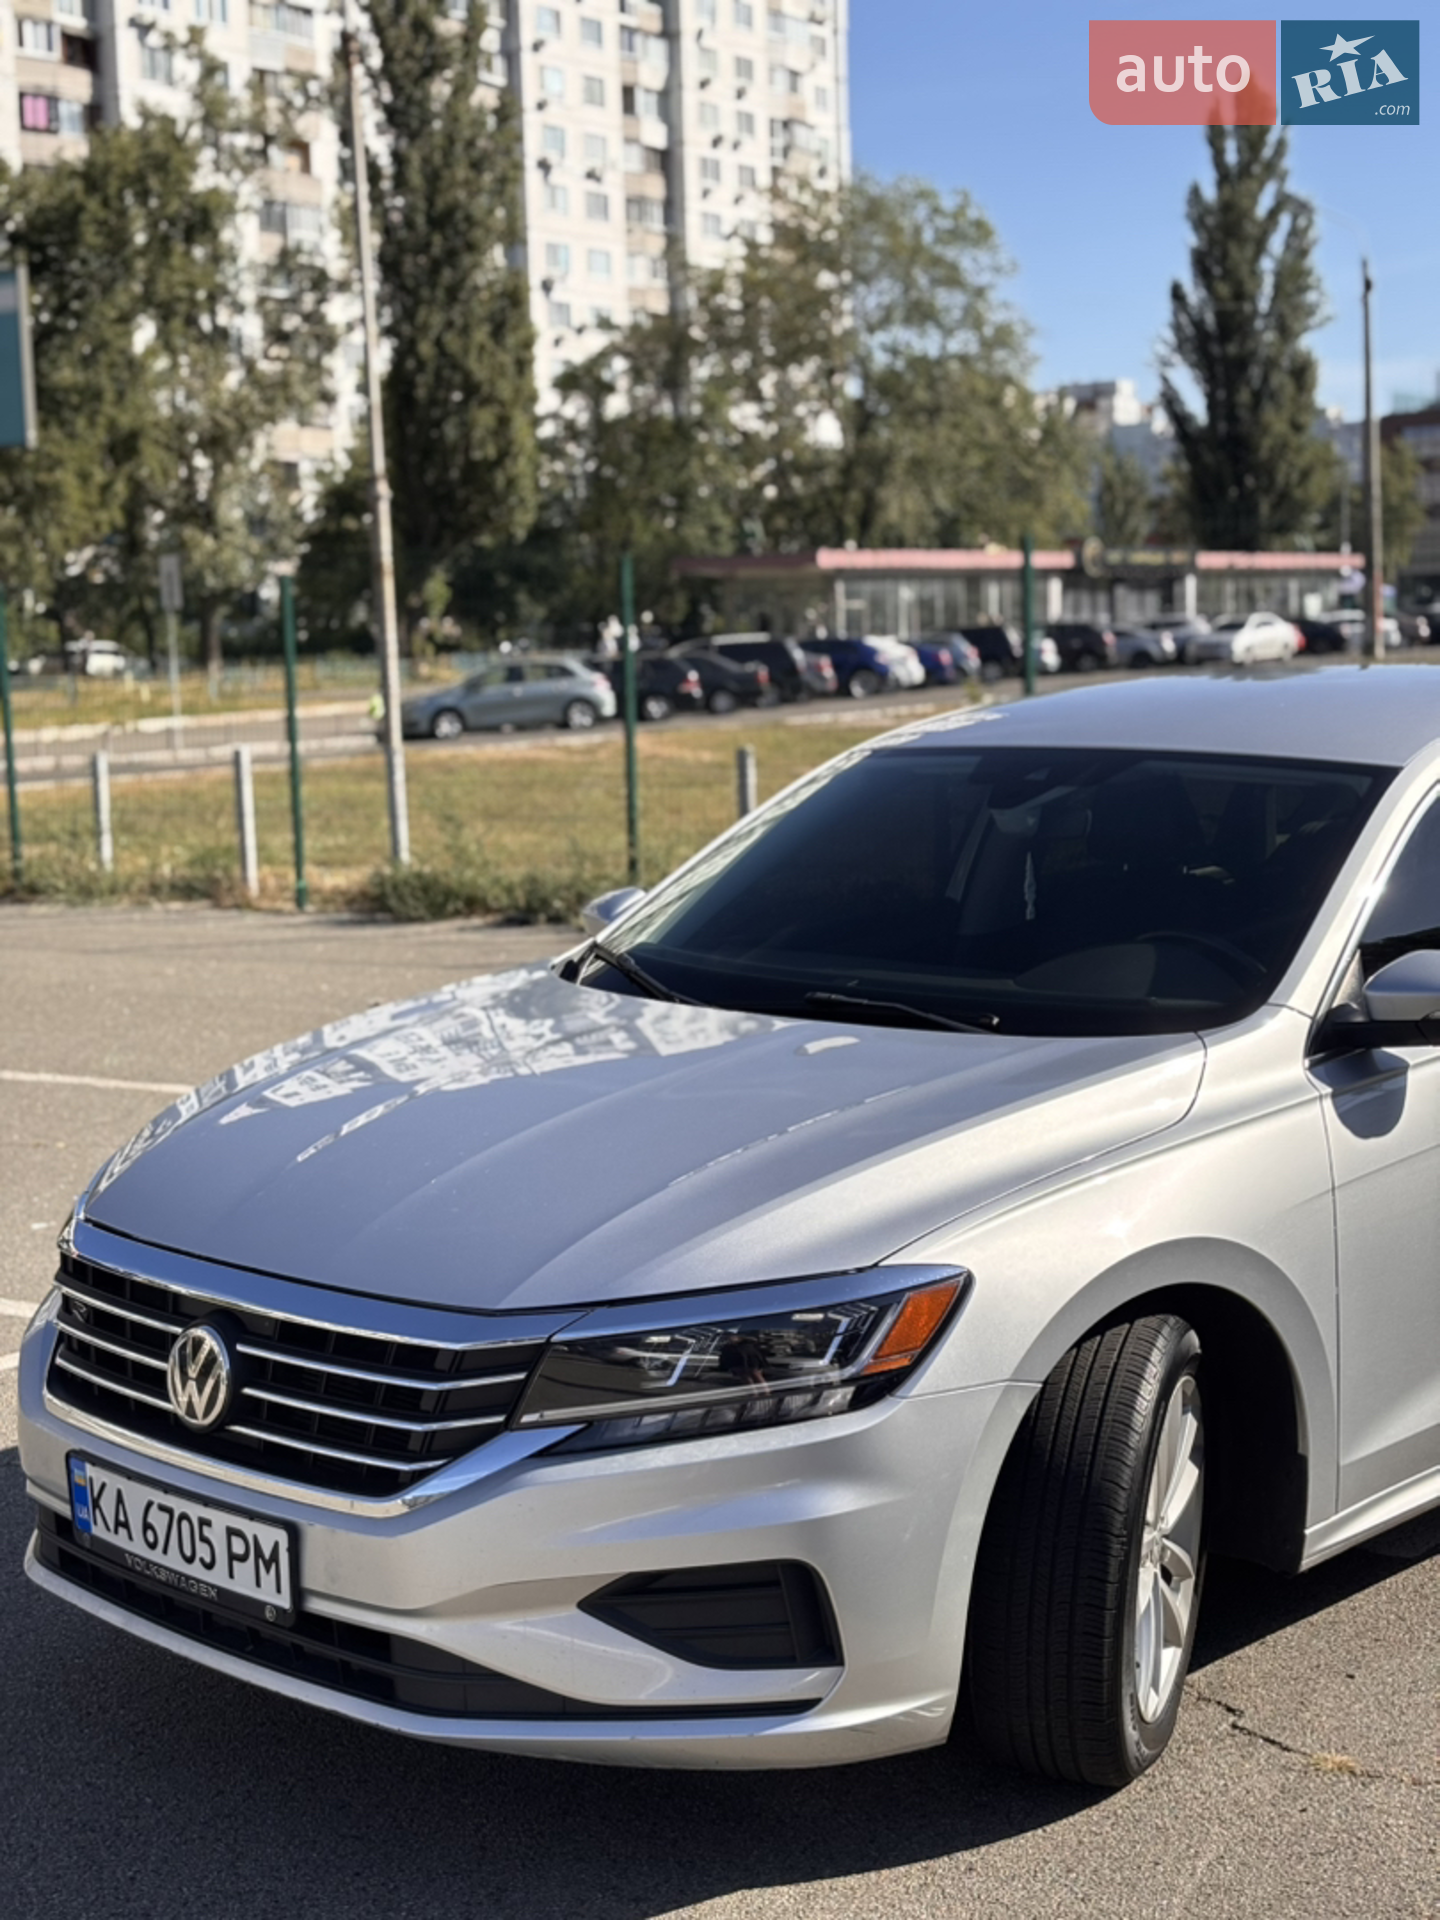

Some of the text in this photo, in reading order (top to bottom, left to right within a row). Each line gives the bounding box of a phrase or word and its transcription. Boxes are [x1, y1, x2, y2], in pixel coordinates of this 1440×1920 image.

[88, 1475, 282, 1595] KA 6705 PM
